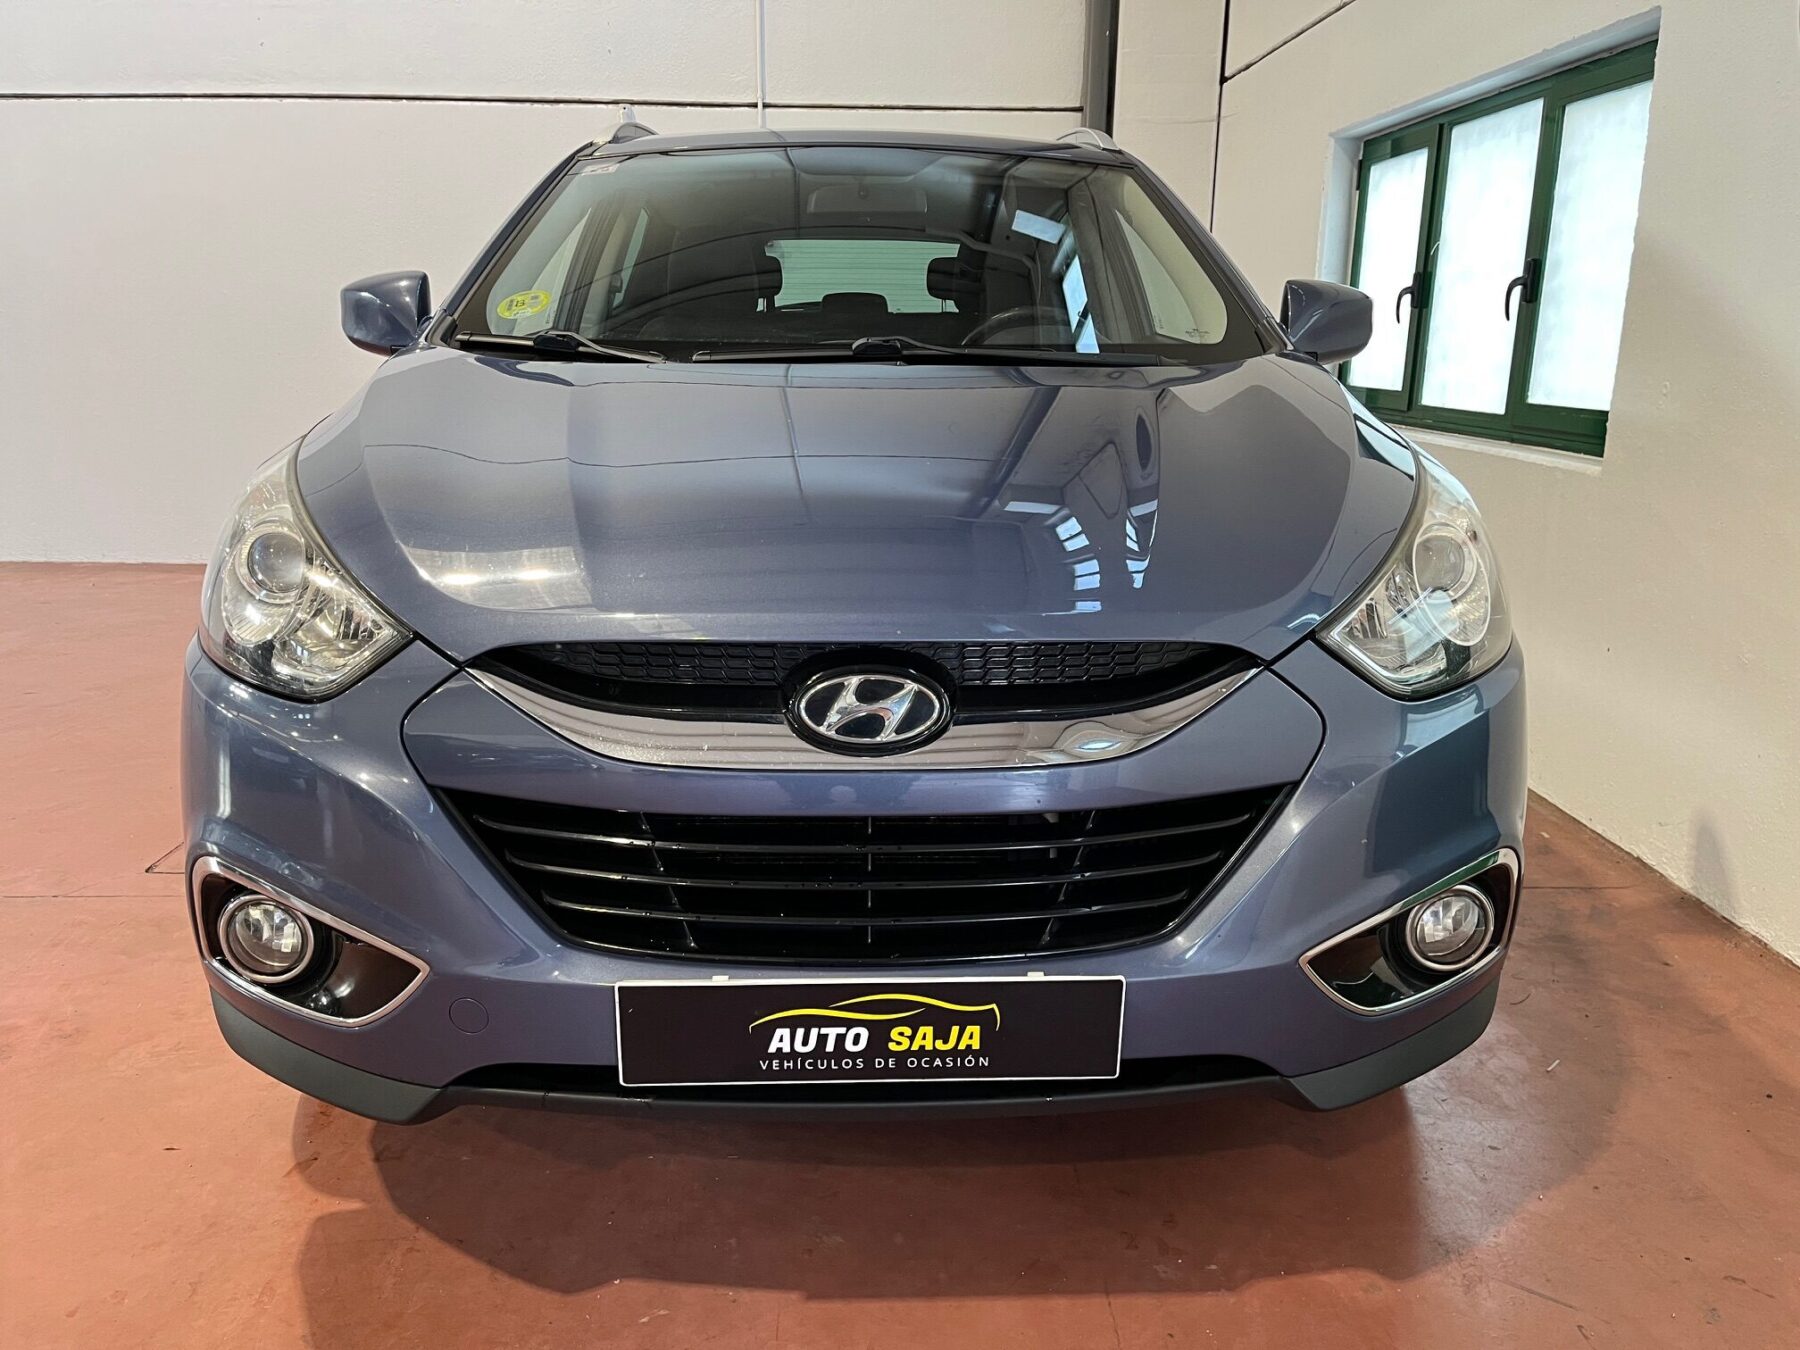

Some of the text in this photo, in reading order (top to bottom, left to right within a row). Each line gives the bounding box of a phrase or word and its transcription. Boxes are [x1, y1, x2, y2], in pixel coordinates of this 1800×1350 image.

[767, 1025, 981, 1054] AUTO SAJA
[759, 1054, 990, 1071] VEHÍCULOS DE OCASIÓN
